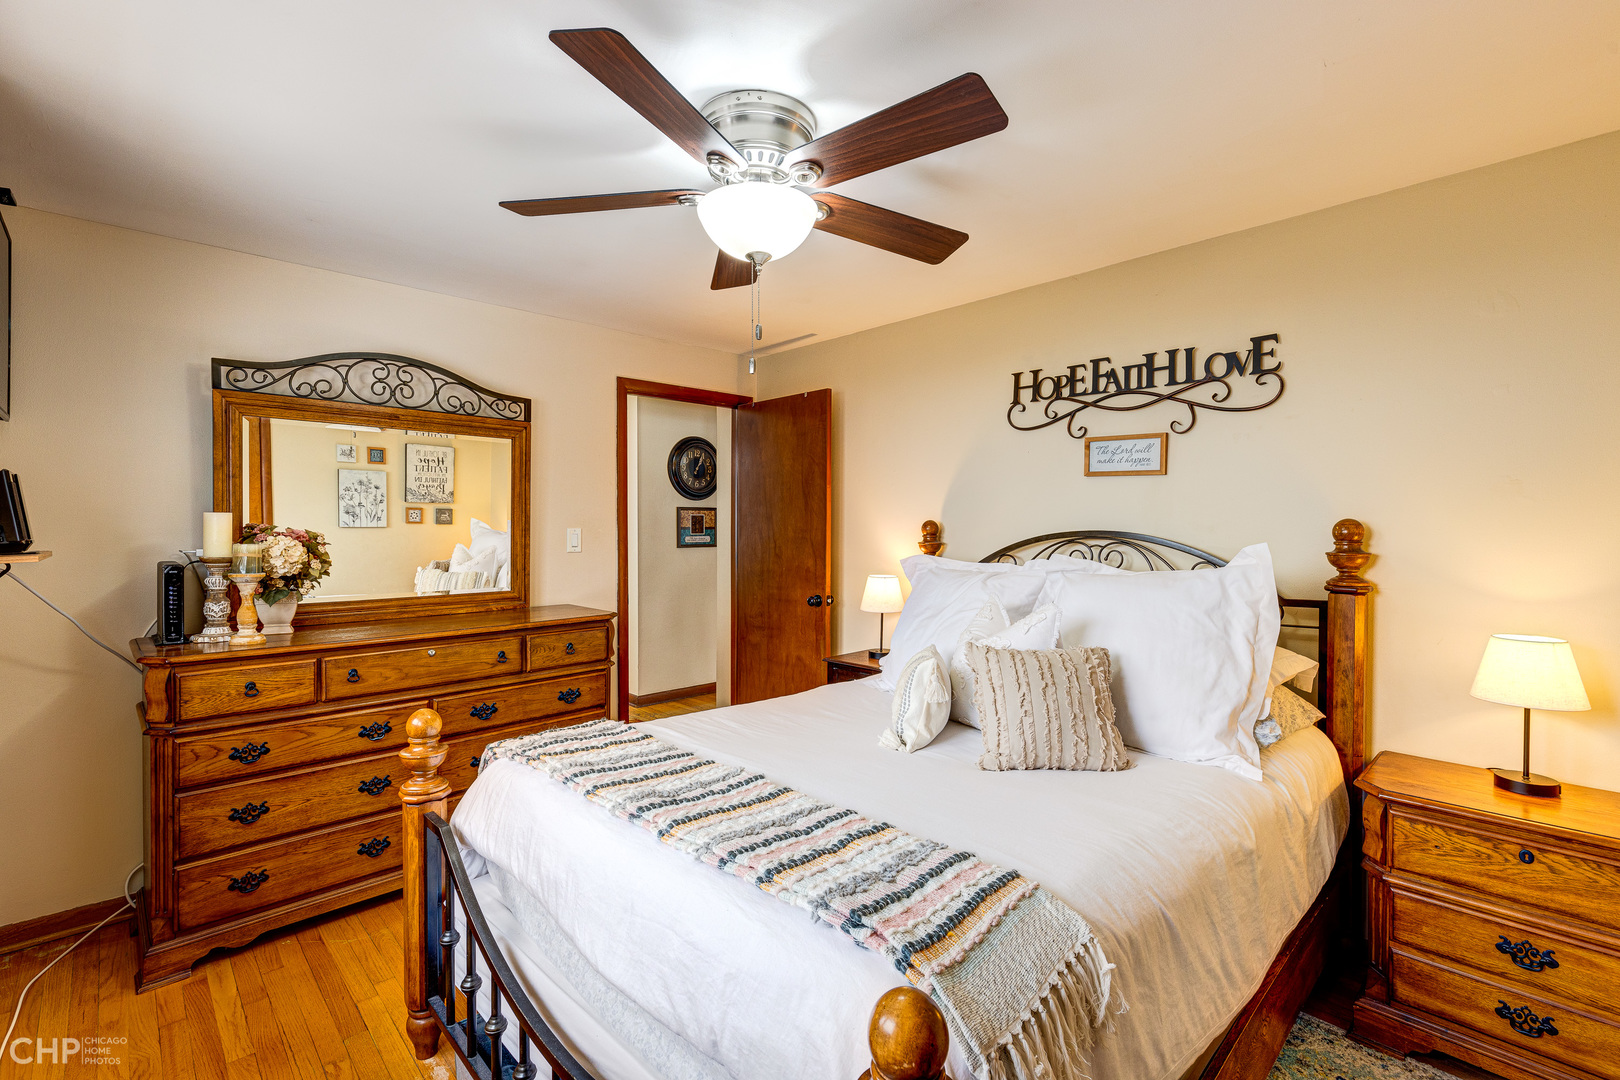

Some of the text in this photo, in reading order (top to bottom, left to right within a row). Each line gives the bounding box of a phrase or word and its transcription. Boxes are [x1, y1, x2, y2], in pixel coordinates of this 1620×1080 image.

[694, 449, 701, 457] 12
[1095, 442, 1155, 456] The Lord will
[1096, 454, 1116, 464] make
[1116, 456, 1124, 464] it
